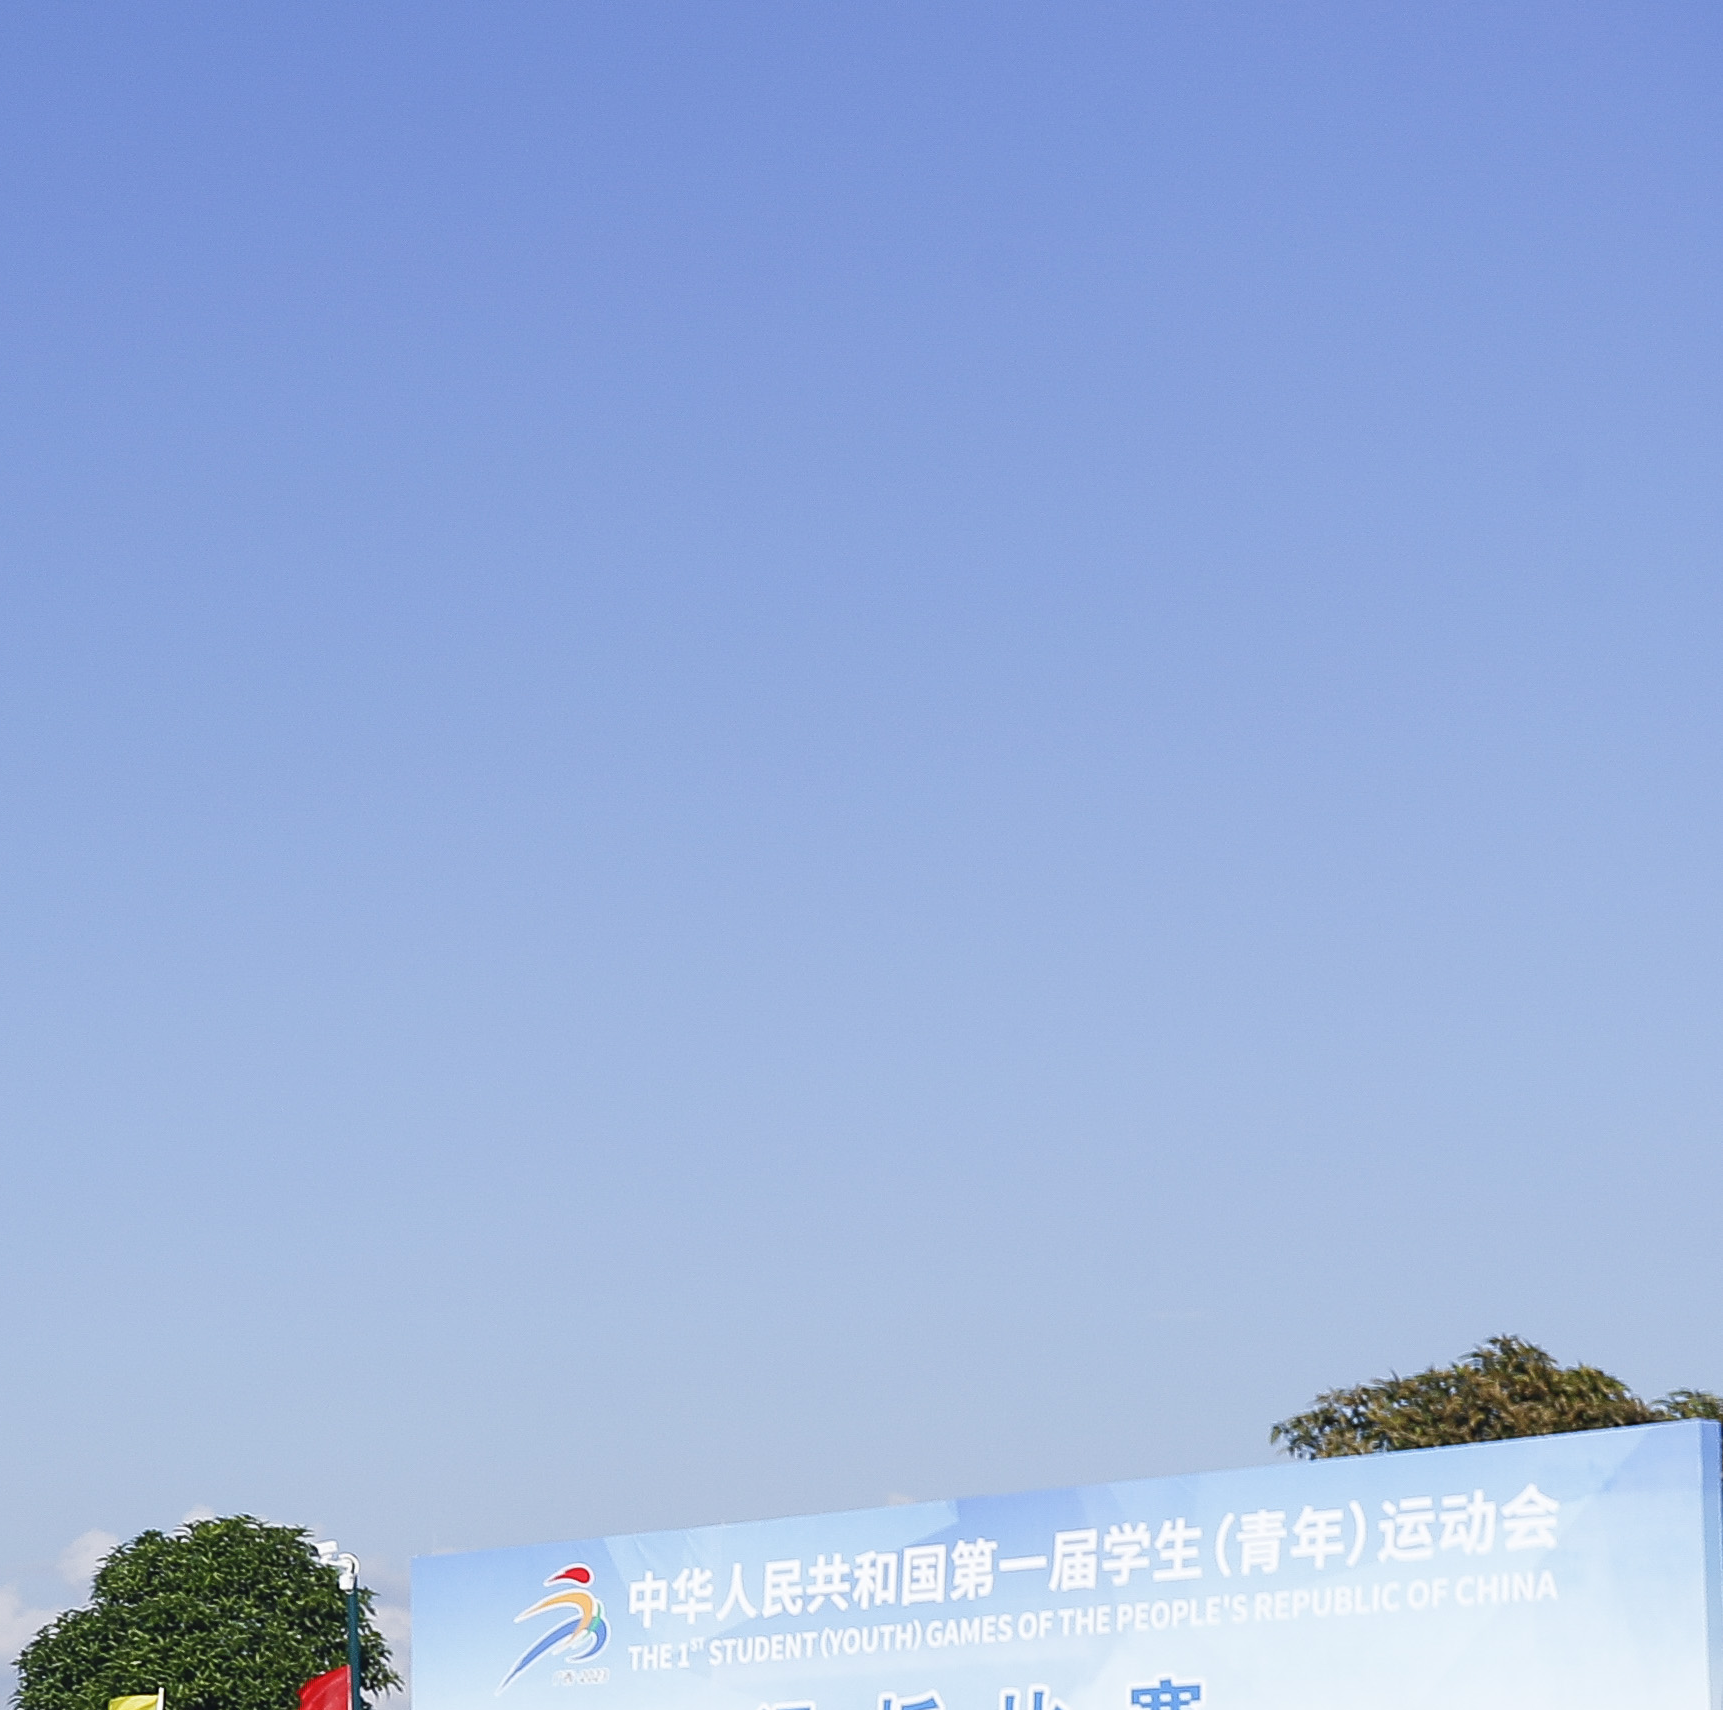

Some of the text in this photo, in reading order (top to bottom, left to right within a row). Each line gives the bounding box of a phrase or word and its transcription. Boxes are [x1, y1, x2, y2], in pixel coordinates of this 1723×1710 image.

[628, 1483, 1561, 1628] 中华人民共和国第一届学生（青年）运动会
[628, 1643, 672, 1671] THE
[930, 1614, 1013, 1648] GAMES
[1018, 1609, 1053, 1640] OF
[1058, 1606, 1111, 1637] THE
[1117, 1593, 1248, 1632] PEOPLE'S
[1254, 1581, 1401, 1622] REPUBLIC
[1407, 1577, 1449, 1610] OF
[1455, 1569, 1560, 1607] CHINA
